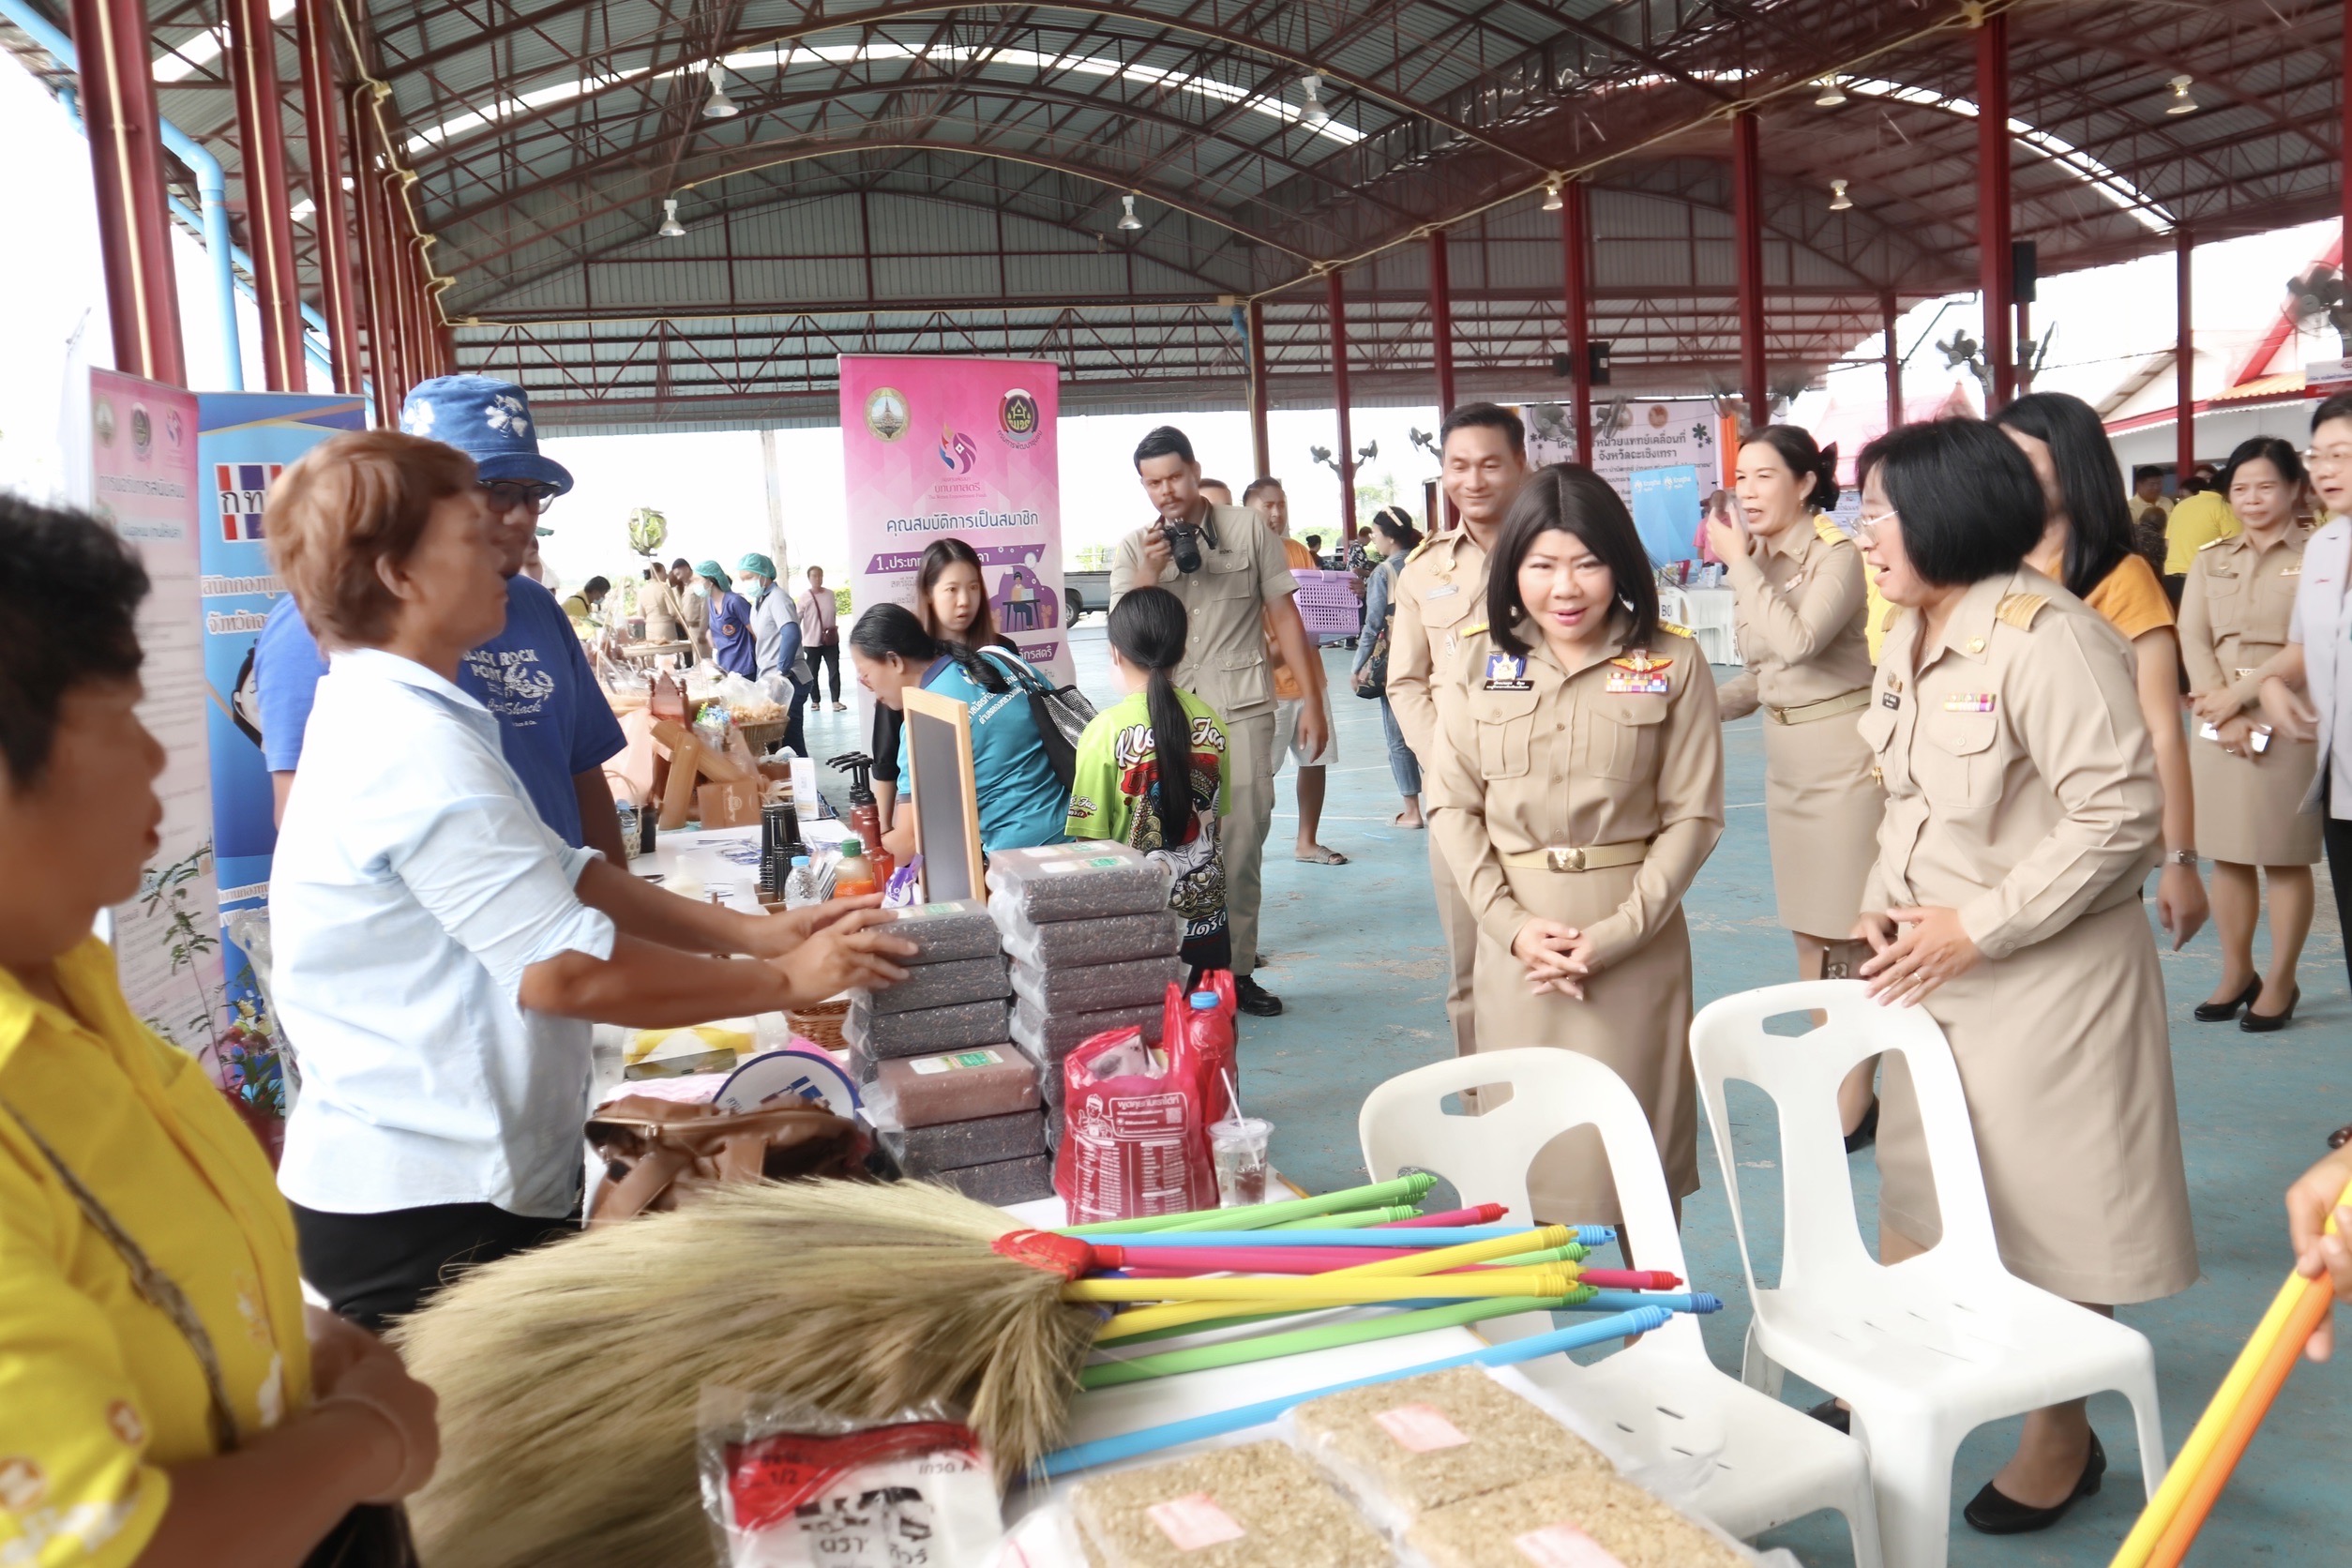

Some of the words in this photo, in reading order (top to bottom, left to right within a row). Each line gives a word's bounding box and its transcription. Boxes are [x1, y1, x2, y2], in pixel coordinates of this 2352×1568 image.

[886, 509, 1039, 537] คุณสมบัติการเป็นสมาชิก
[499, 649, 539, 666] ROCK
[505, 699, 541, 716] Shack
[1116, 725, 1155, 768] Klo
[770, 1469, 798, 1485] 1/2
